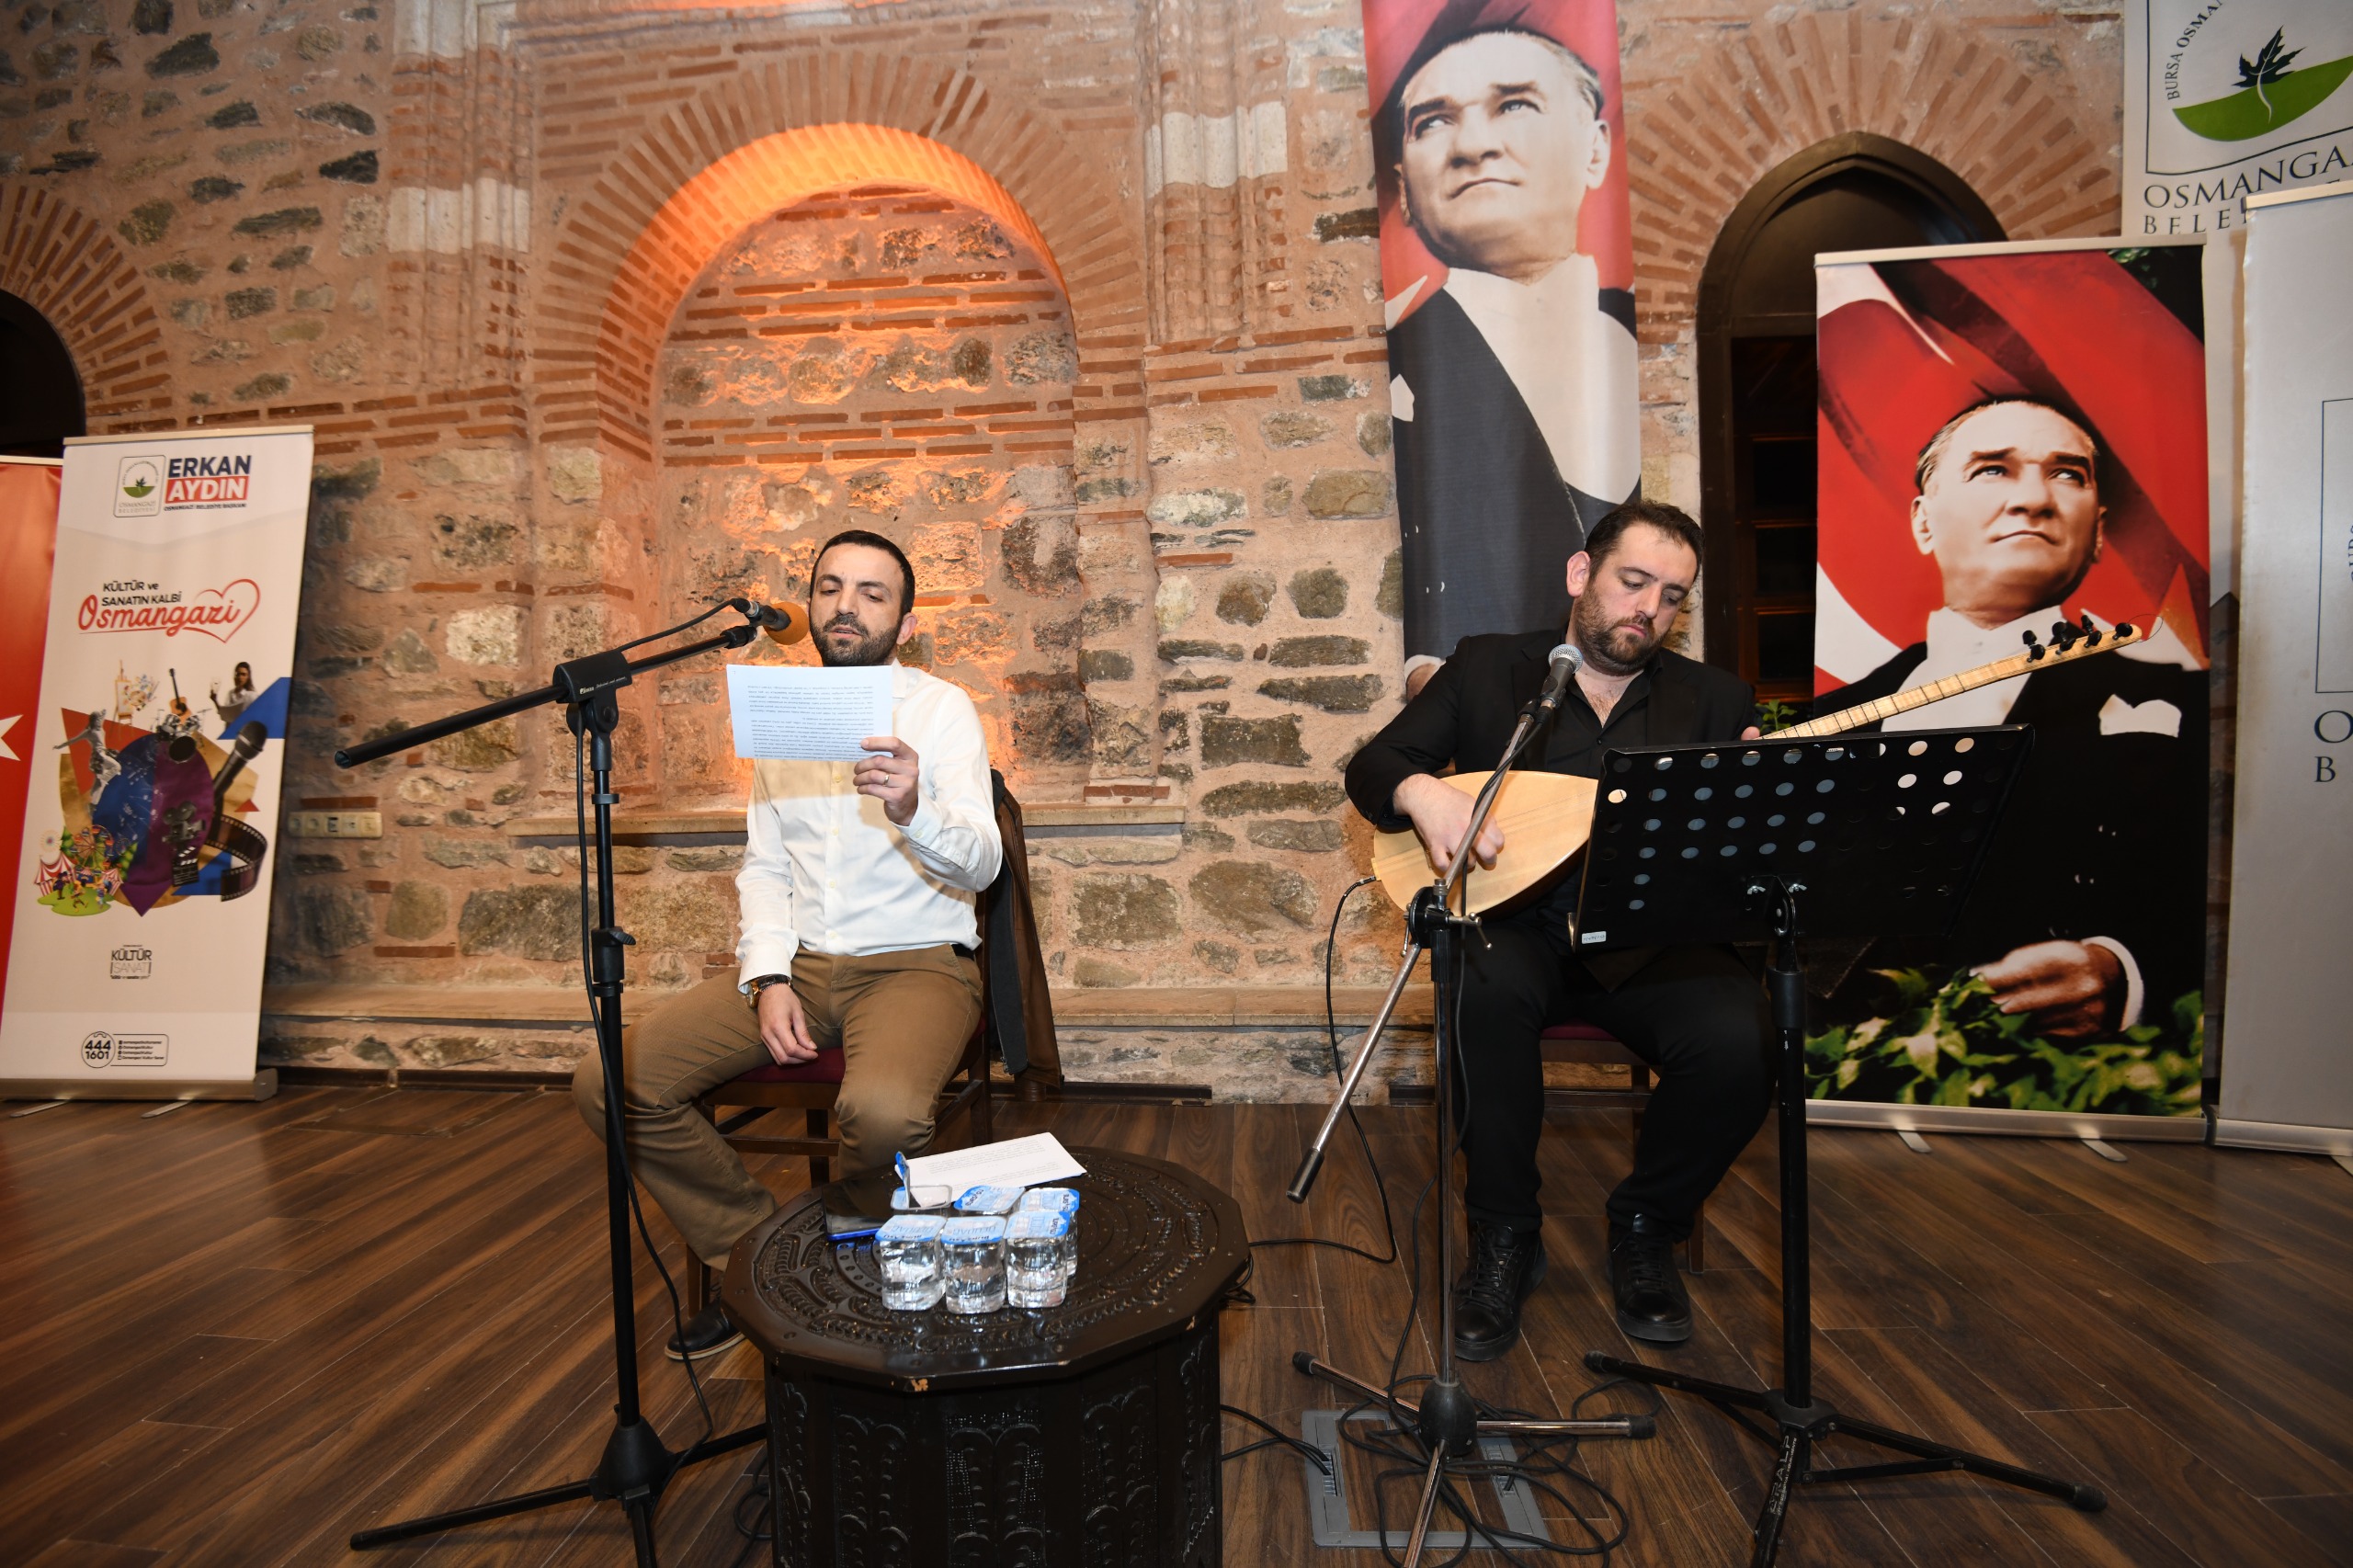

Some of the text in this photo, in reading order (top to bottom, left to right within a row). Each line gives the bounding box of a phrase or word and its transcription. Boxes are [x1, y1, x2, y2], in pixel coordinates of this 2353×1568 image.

[2165, 0, 2222, 100] BURSA OSMA
[2143, 145, 2353, 209] OSMANGA
[2143, 208, 2247, 235] BELE
[168, 455, 252, 478] ERKAN
[167, 478, 246, 502] AYDIN
[103, 580, 160, 592] KÜLTÜR ve
[101, 591, 183, 607] SANATIN KALBİ
[78, 594, 241, 637] Osmangazi
[111, 948, 153, 961] KÜLTÜR
[85, 1040, 111, 1051] 444
[85, 1051, 109, 1060] 1601
